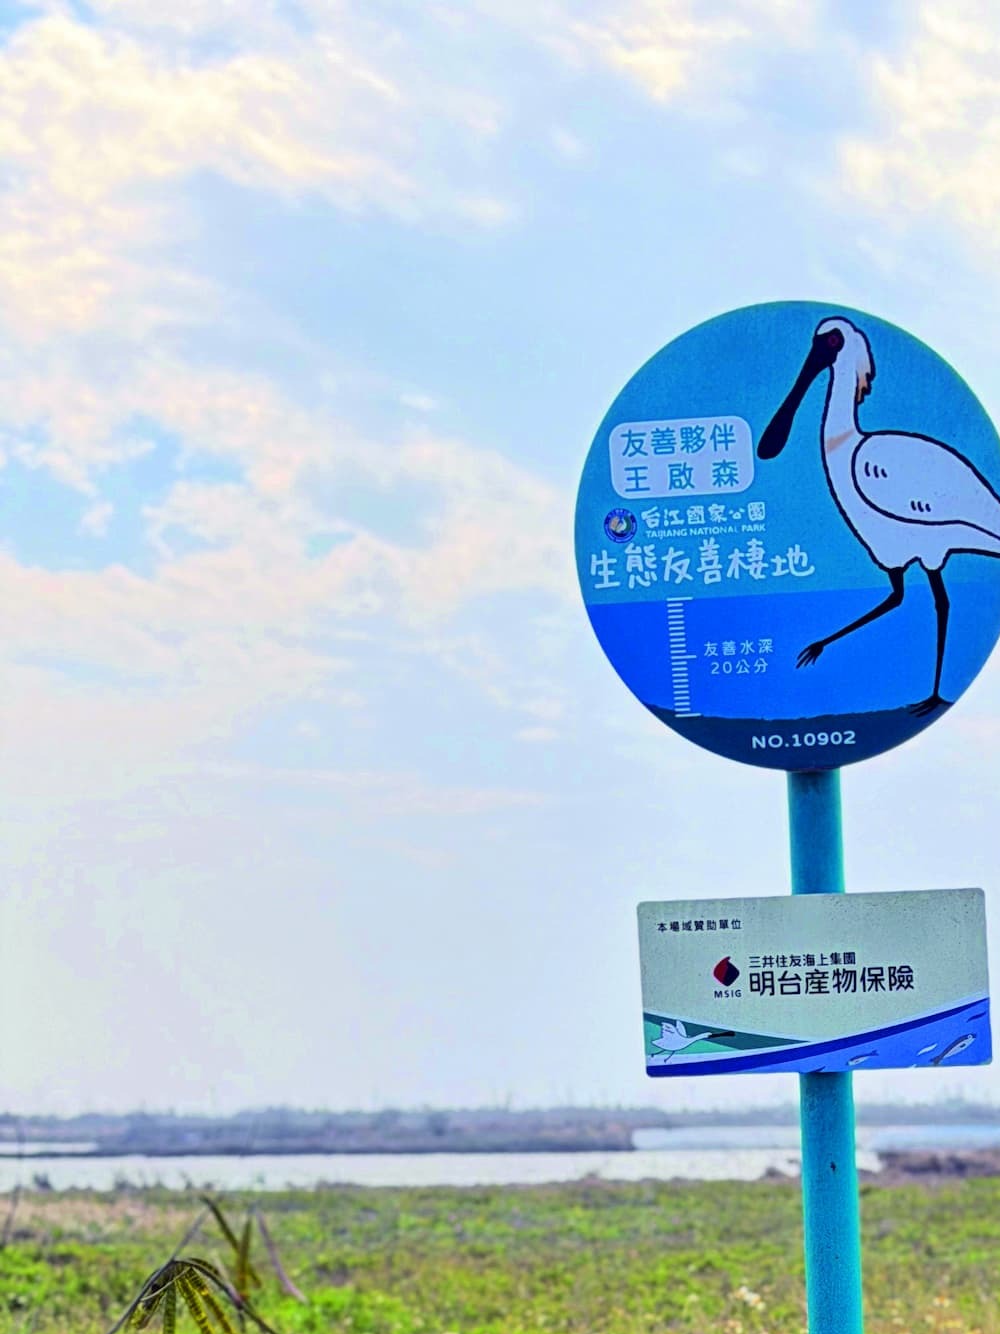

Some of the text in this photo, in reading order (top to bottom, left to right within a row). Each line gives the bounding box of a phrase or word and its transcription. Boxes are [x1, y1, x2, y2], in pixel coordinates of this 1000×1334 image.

[620, 423, 737, 458] 友善夥伴
[641, 501, 766, 529] 台江國家公園
[645, 523, 766, 540] TAIJIANG NATIONAL PARK
[589, 537, 815, 590] 生態友善棲地
[703, 638, 773, 657] 友善水深
[710, 657, 768, 675] 20公分
[751, 730, 857, 749] NO.10902
[748, 951, 856, 968] 三井住友海上集團
[713, 989, 742, 999] MSIG
